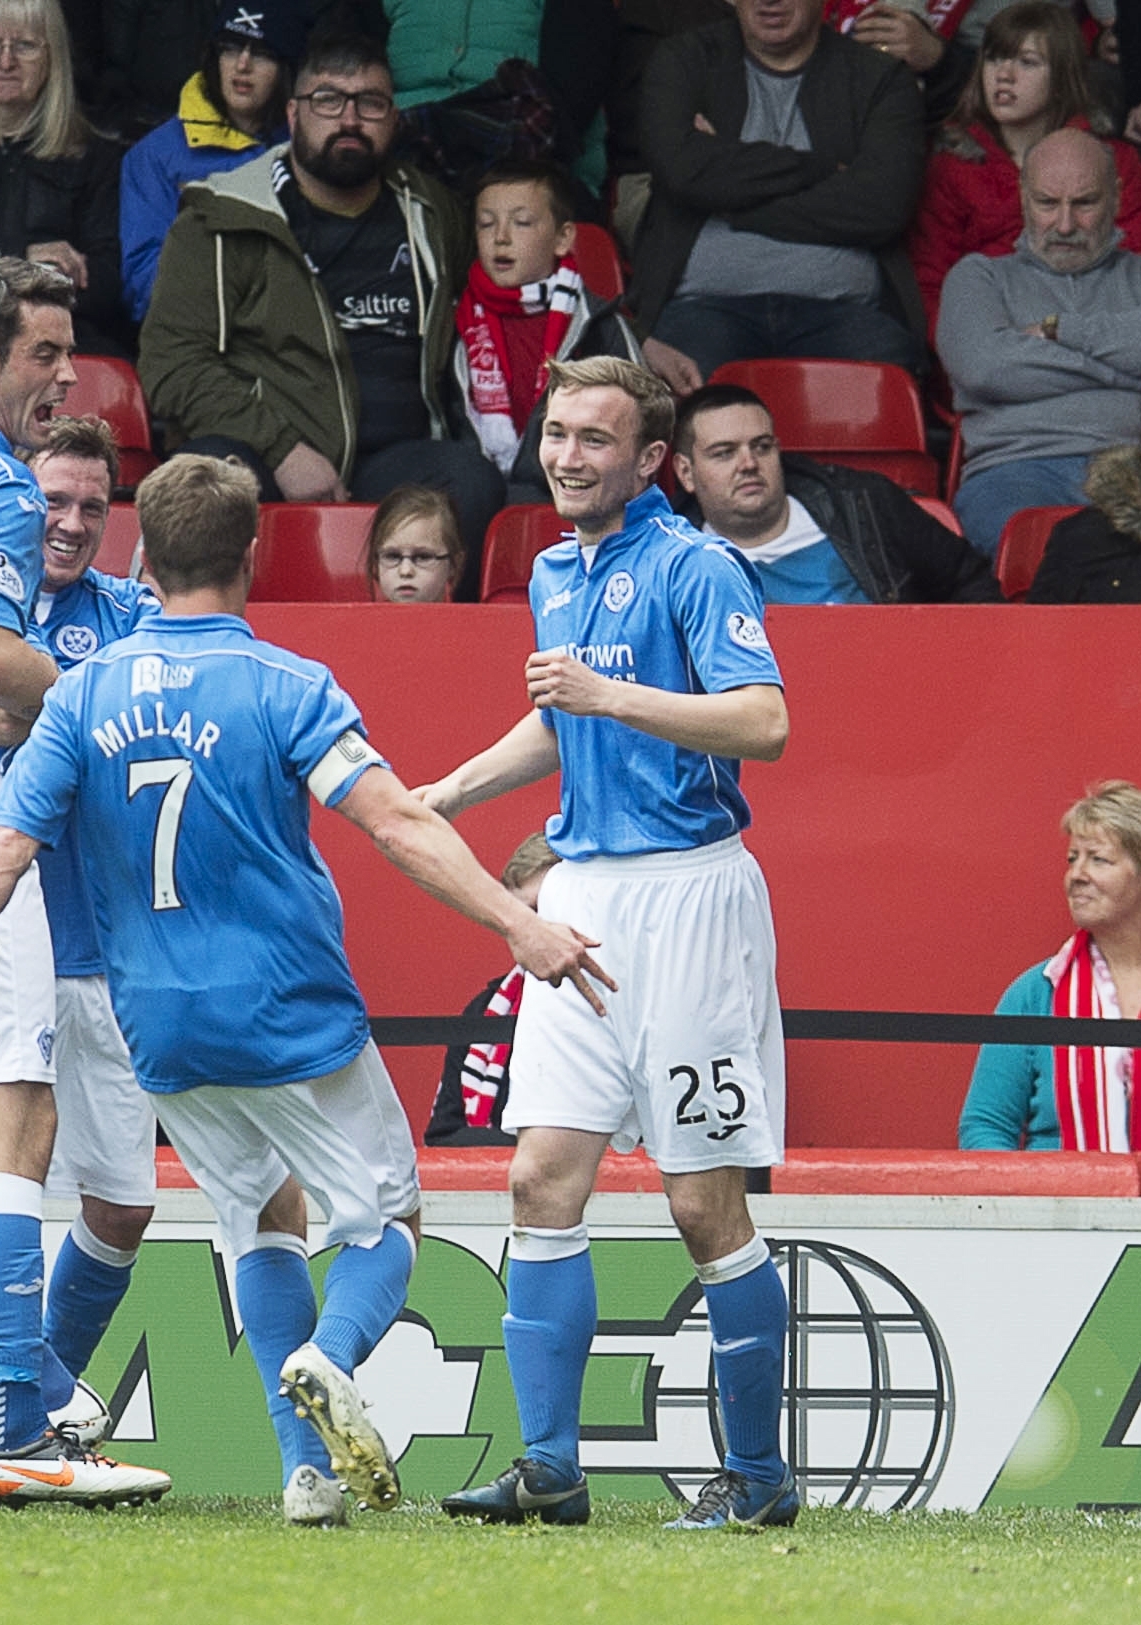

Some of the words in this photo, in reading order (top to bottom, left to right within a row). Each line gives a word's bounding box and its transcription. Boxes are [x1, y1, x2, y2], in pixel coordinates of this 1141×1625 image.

[344, 293, 410, 316] Saltire
[91, 701, 221, 758] MILLAR
[127, 757, 194, 911] 7
[669, 1057, 745, 1125] 25
